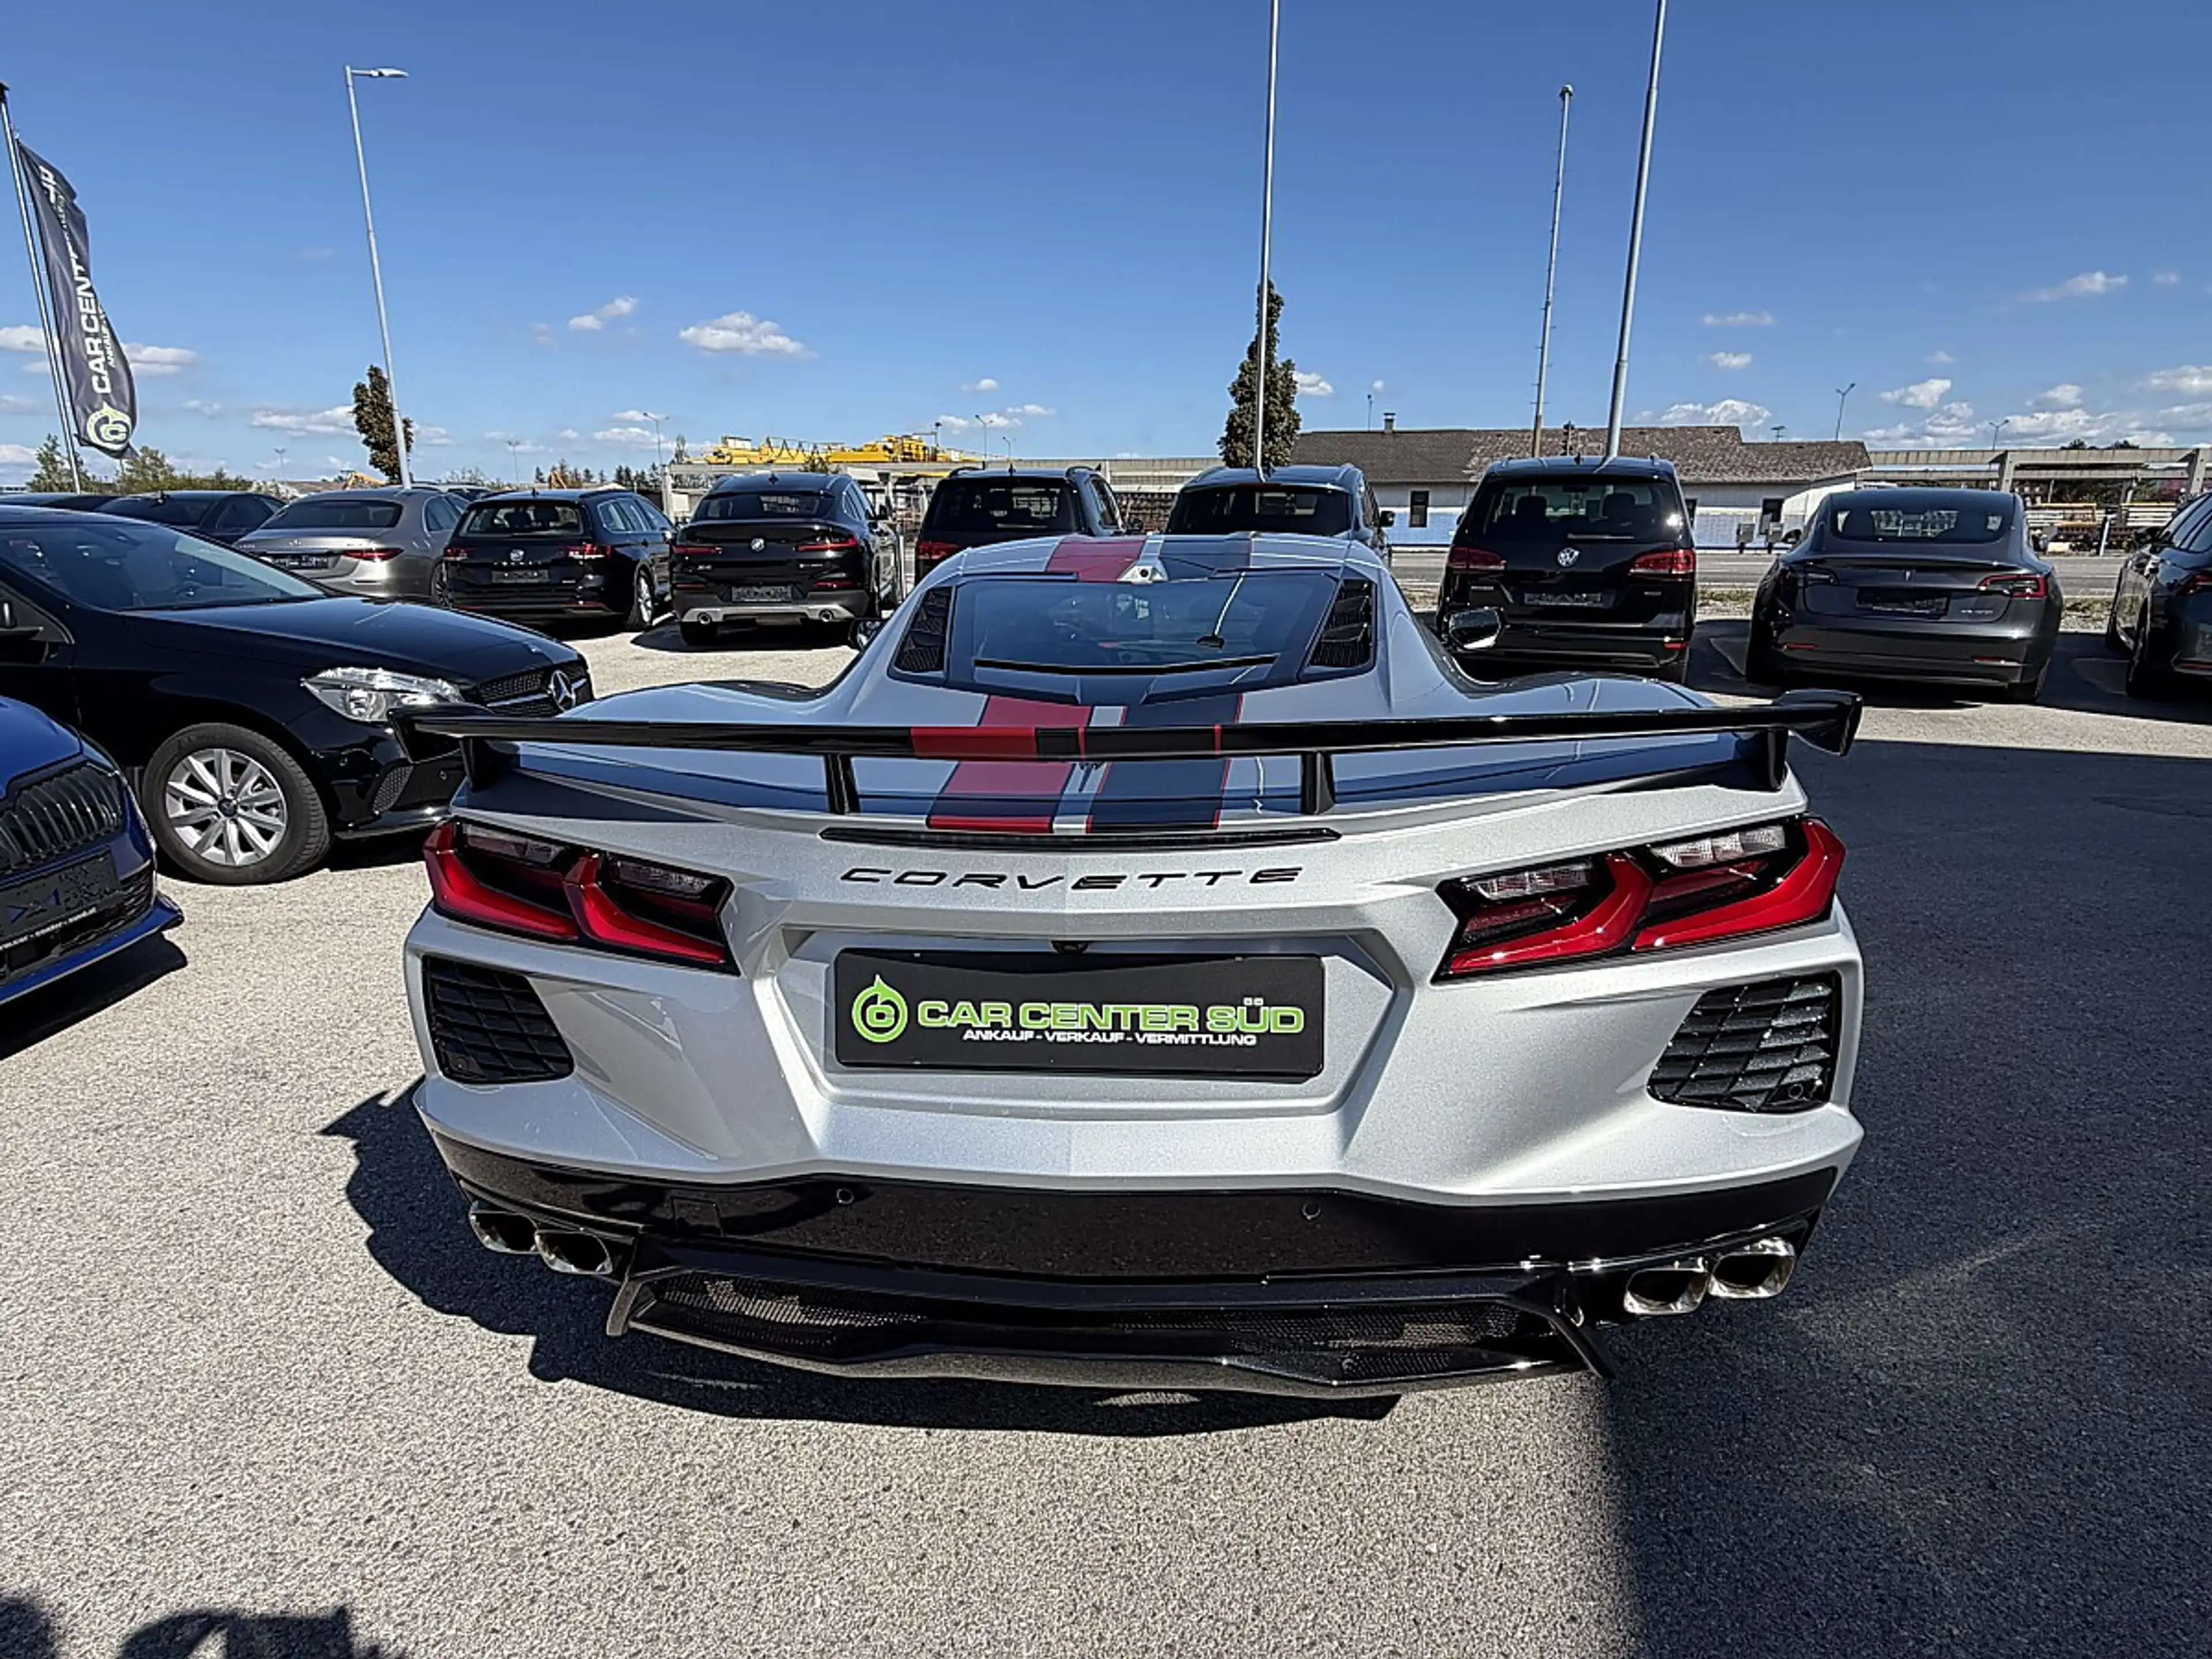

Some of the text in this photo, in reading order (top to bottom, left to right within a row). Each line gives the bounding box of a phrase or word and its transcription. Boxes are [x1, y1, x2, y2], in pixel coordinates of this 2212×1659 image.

[85, 336, 112, 395] CAR
[840, 866, 1302, 890] CORVETTE
[918, 997, 1304, 1033] CAR CENTER SÜD
